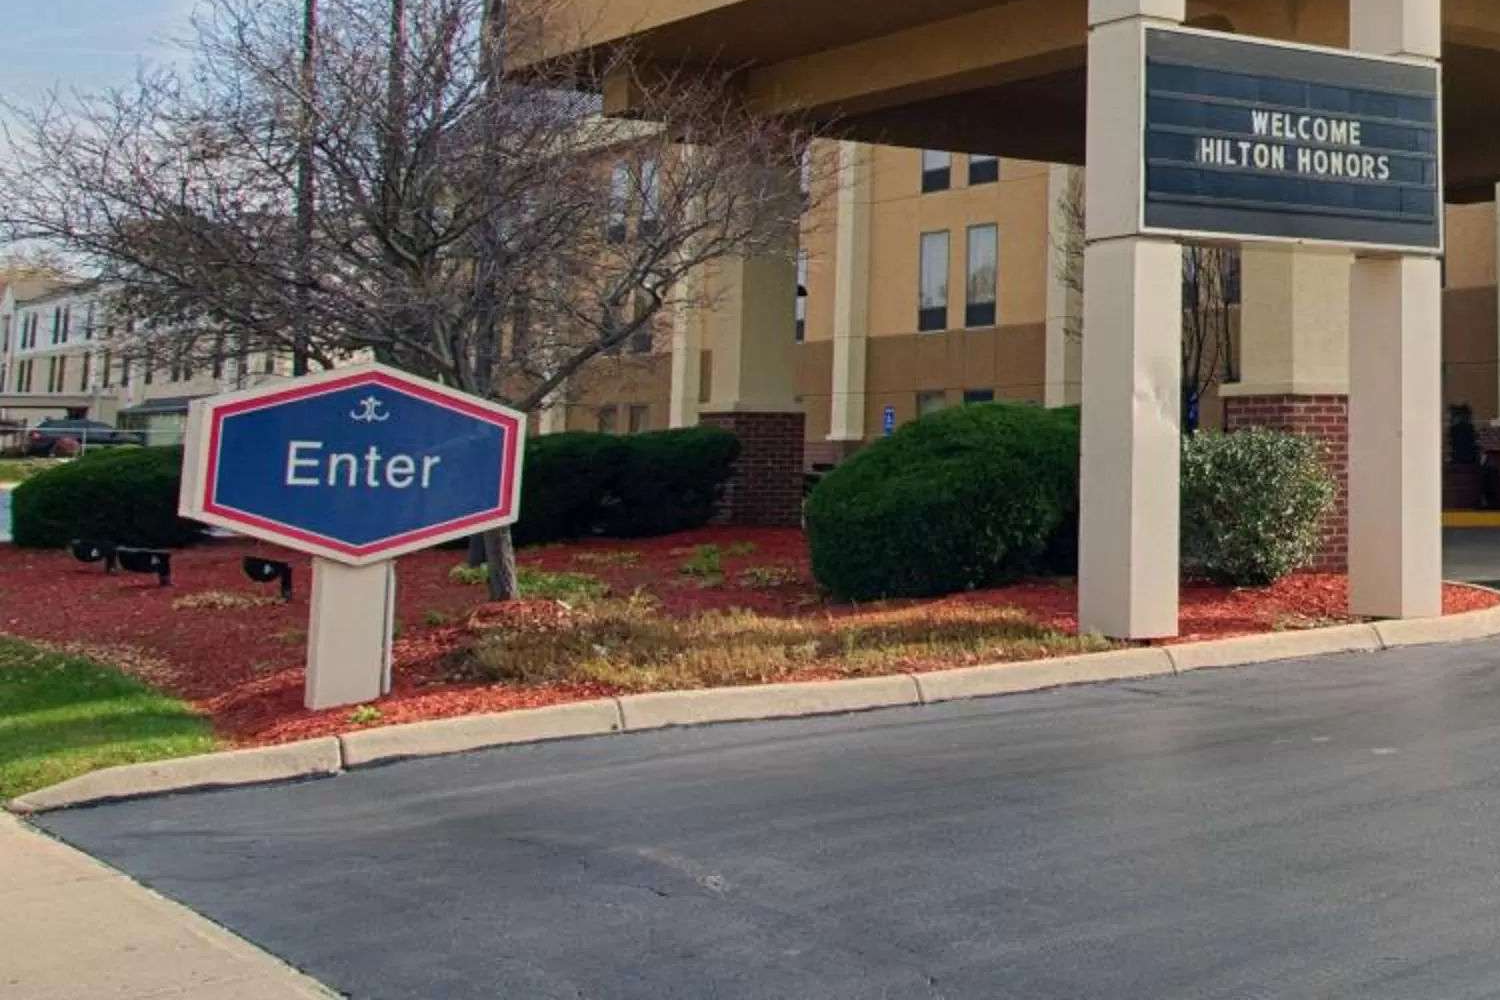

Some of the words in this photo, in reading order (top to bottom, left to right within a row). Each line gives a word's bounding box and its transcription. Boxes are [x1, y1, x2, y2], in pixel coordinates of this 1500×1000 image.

[1251, 108, 1362, 146] WELCOME
[1200, 137, 1286, 171] HILTON
[1297, 147, 1390, 181] HONORS
[285, 440, 441, 489] Enter
